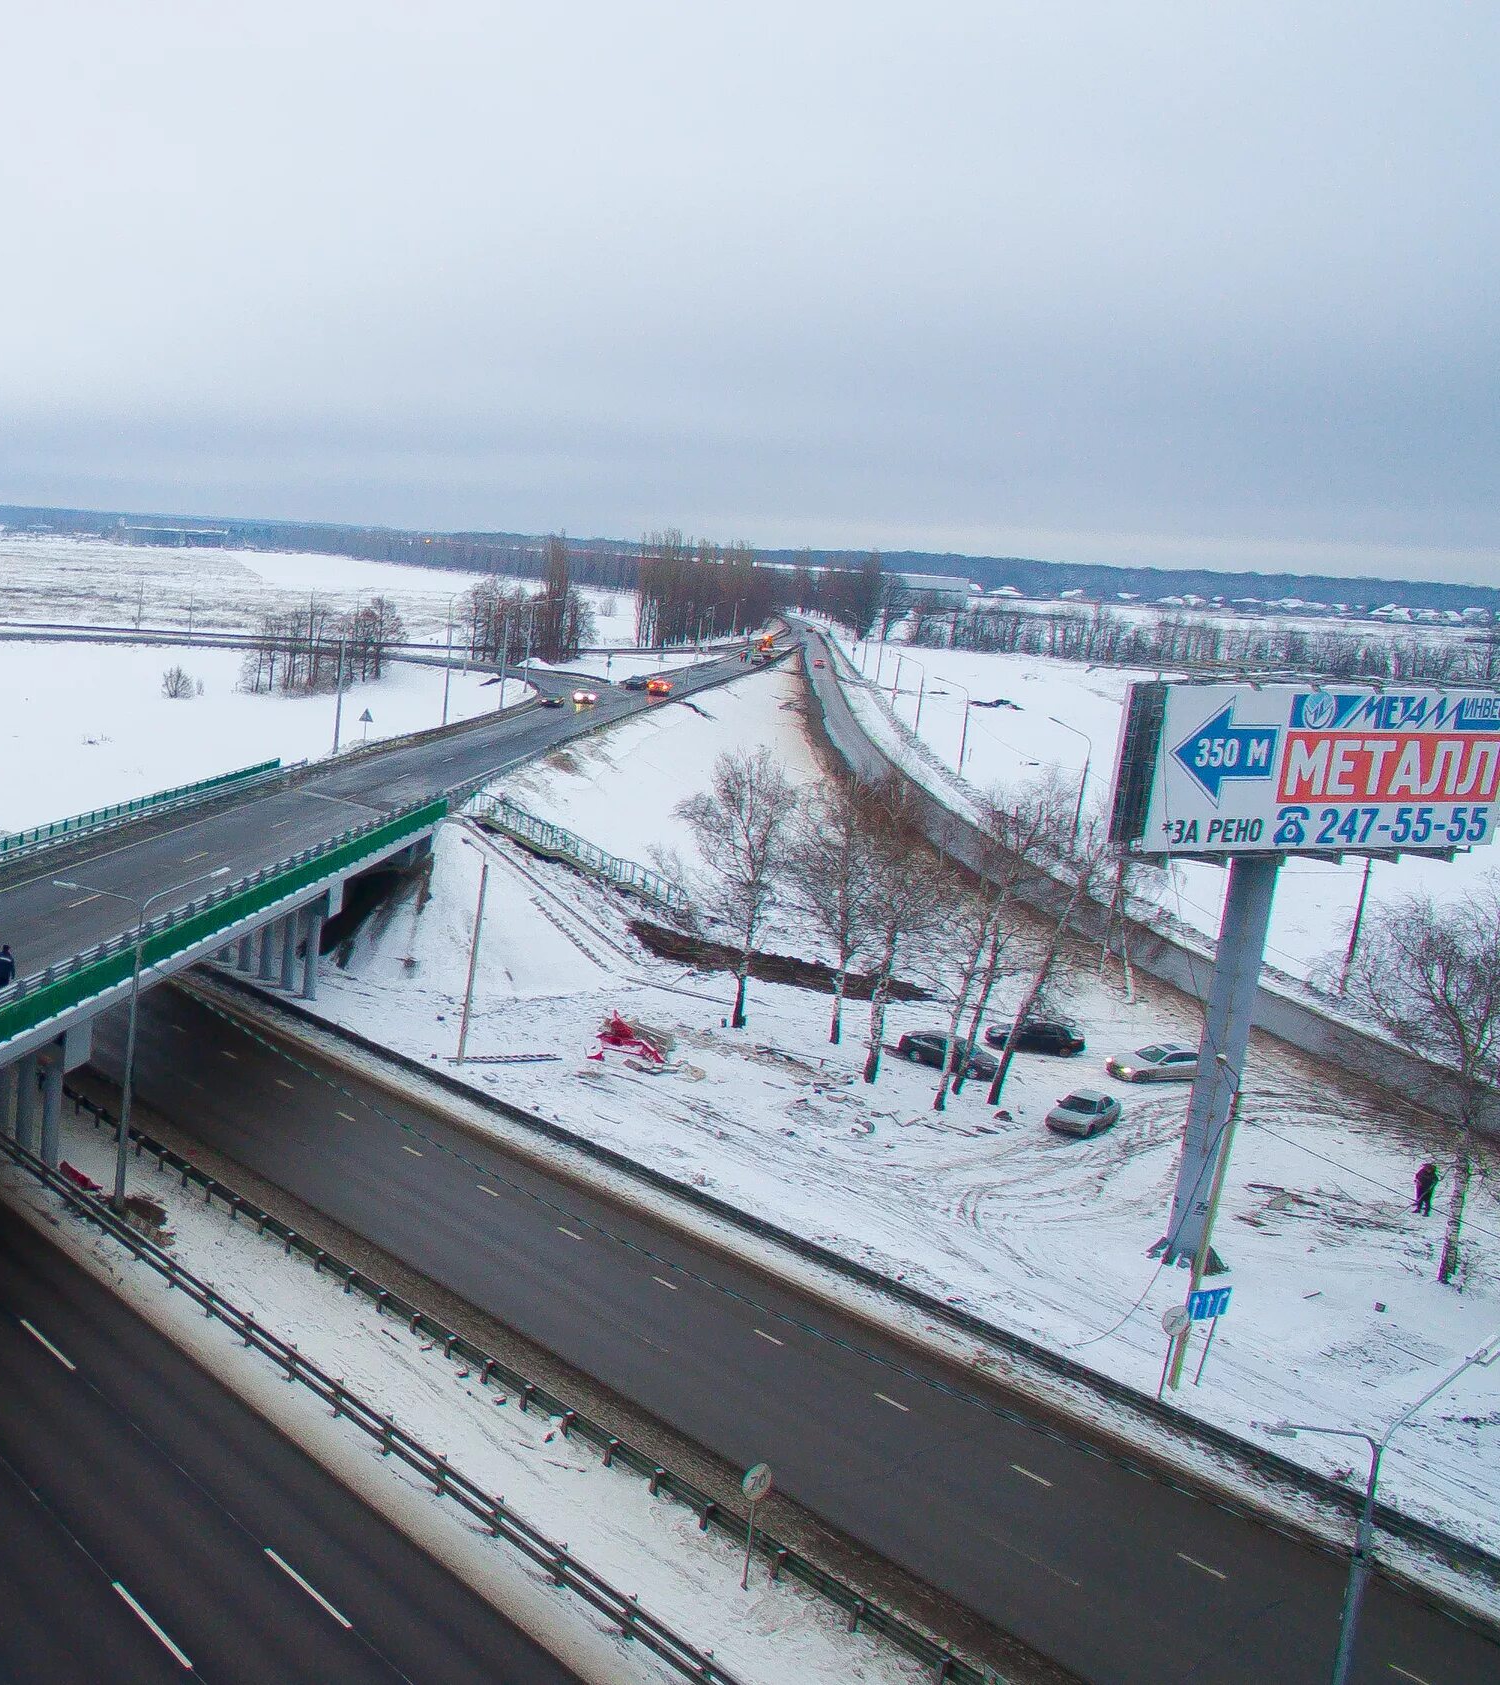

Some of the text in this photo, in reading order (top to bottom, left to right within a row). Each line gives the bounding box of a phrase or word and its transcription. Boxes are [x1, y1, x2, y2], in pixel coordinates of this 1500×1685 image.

[1464, 697, 1500, 719] ИНВЕ
[1195, 738, 1269, 768] 350 М
[1284, 739, 1500, 796] МЕТАЛЛ
[1206, 817, 1265, 844] РЕНО
[1314, 806, 1489, 845] 247-55-55
[750, 1473, 767, 1490] 70
